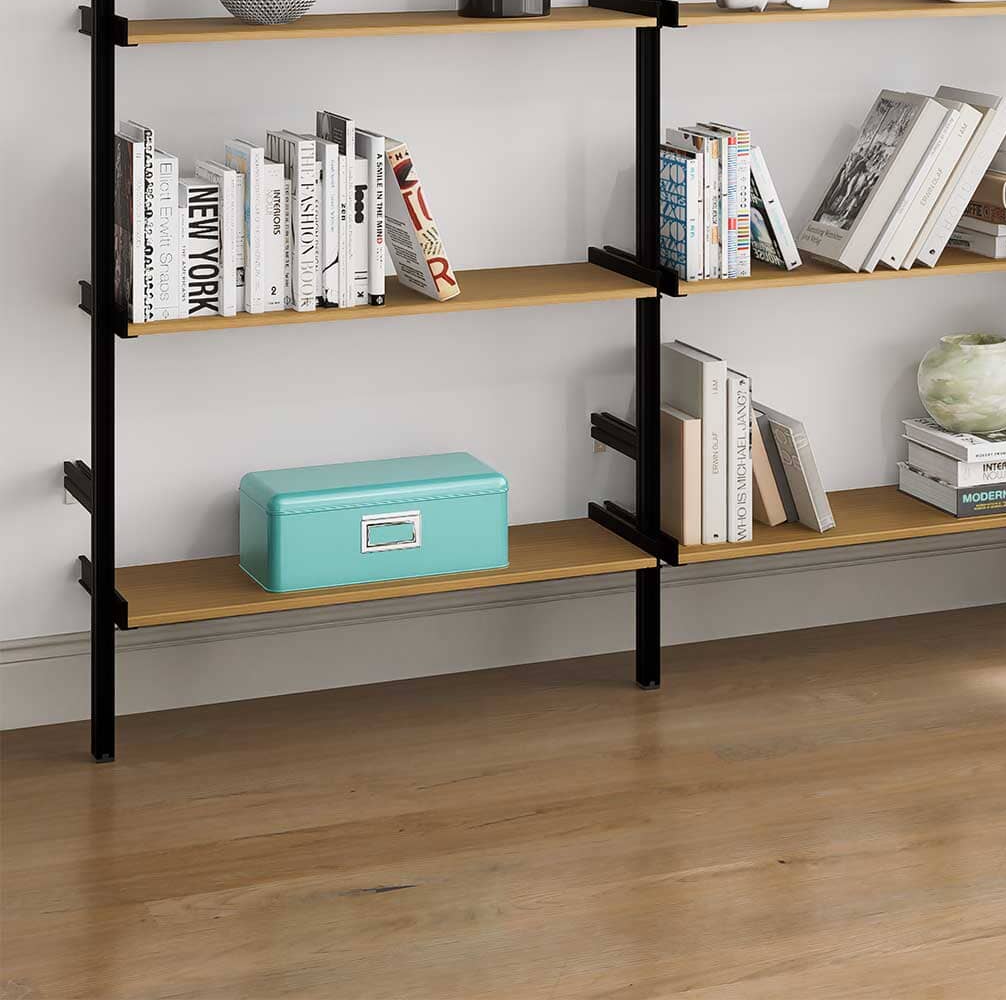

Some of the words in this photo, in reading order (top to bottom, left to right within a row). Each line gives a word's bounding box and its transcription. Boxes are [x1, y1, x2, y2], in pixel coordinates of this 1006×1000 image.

[159, 162, 173, 201] Elliott
[300, 143, 314, 179] THE
[188, 187, 219, 240] NEW
[273, 189, 281, 236] INTERIORS
[376, 190, 383, 200] IN
[159, 206, 173, 247] Erwitt
[300, 183, 314, 255] FASHION
[188, 247, 219, 315] YORK
[271, 285, 278, 296] 2
[737, 390, 747, 431] JANG?
[737, 433, 747, 490] MICHAEL
[737, 492, 747, 505] IS
[737, 507, 747, 542] WHO
